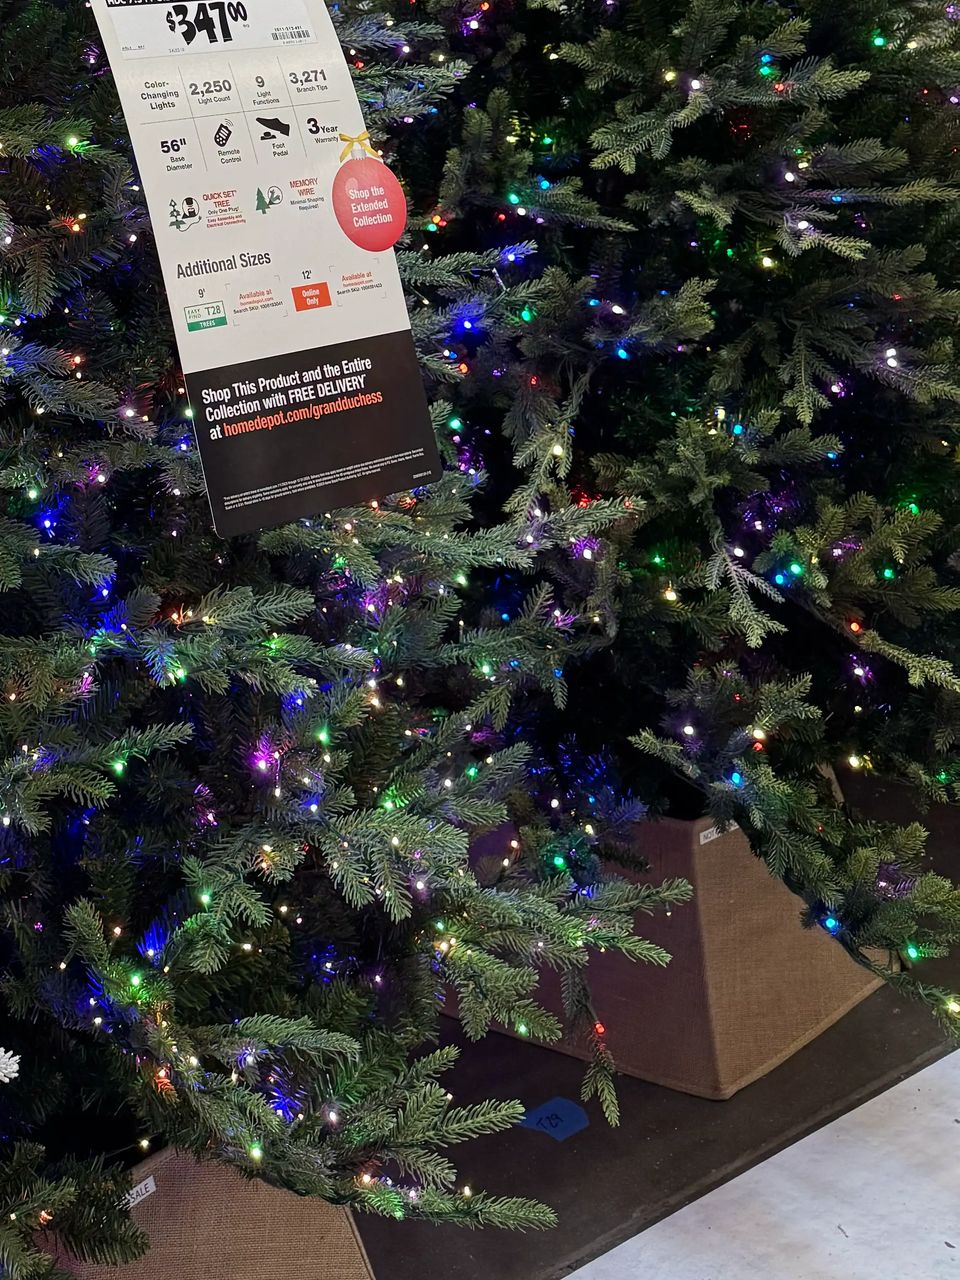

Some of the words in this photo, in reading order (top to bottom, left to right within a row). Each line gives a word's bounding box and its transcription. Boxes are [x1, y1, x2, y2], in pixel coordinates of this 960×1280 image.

[255, 76, 265, 87] 9
[290, 69, 327, 87] 3,271
[144, 81, 169, 89] Color-
[189, 79, 232, 97] 2,250
[316, 84, 328, 92] Tips
[140, 90, 180, 101] Changing
[257, 90, 271, 98] Light
[198, 97, 212, 105] Light
[213, 95, 231, 103] Count
[252, 97, 280, 106] Functions
[150, 101, 176, 110] Lights
[314, 136, 339, 145] Warranty
[160, 138, 187, 154] 56"
[272, 142, 285, 150] Foot
[218, 149, 240, 157] Remote
[170, 155, 185, 163] Base
[220, 156, 242, 165] Control
[166, 163, 193, 172] Diameter
[290, 178, 318, 188] MEMORY
[203, 192, 222, 201] QUICK
[298, 188, 316, 197] WIRE
[349, 189, 370, 200] Shop
[371, 185, 385, 196] the
[213, 200, 230, 208] TREE
[351, 198, 389, 214] Extended
[353, 213, 393, 228] Collection
[177, 255, 238, 279] Additional
[239, 252, 272, 268] Sizes
[341, 273, 366, 282] Available
[239, 290, 265, 300] Available
[302, 288, 320, 297] Online
[306, 297, 319, 306] Only
[205, 305, 221, 316] T28
[200, 320, 216, 328] TREES
[201, 386, 231, 404] Shop
[232, 381, 257, 398] This
[258, 371, 300, 393] Product
[302, 366, 322, 382] and
[323, 363, 341, 378] the
[342, 358, 372, 375] Entire
[205, 399, 261, 422] Collection
[262, 393, 287, 408] with
[288, 385, 316, 404] FREE
[209, 426, 223, 441] at
[224, 390, 383, 437] homedepot.com/grandduchess
[130, 1183, 150, 1202] SALE
